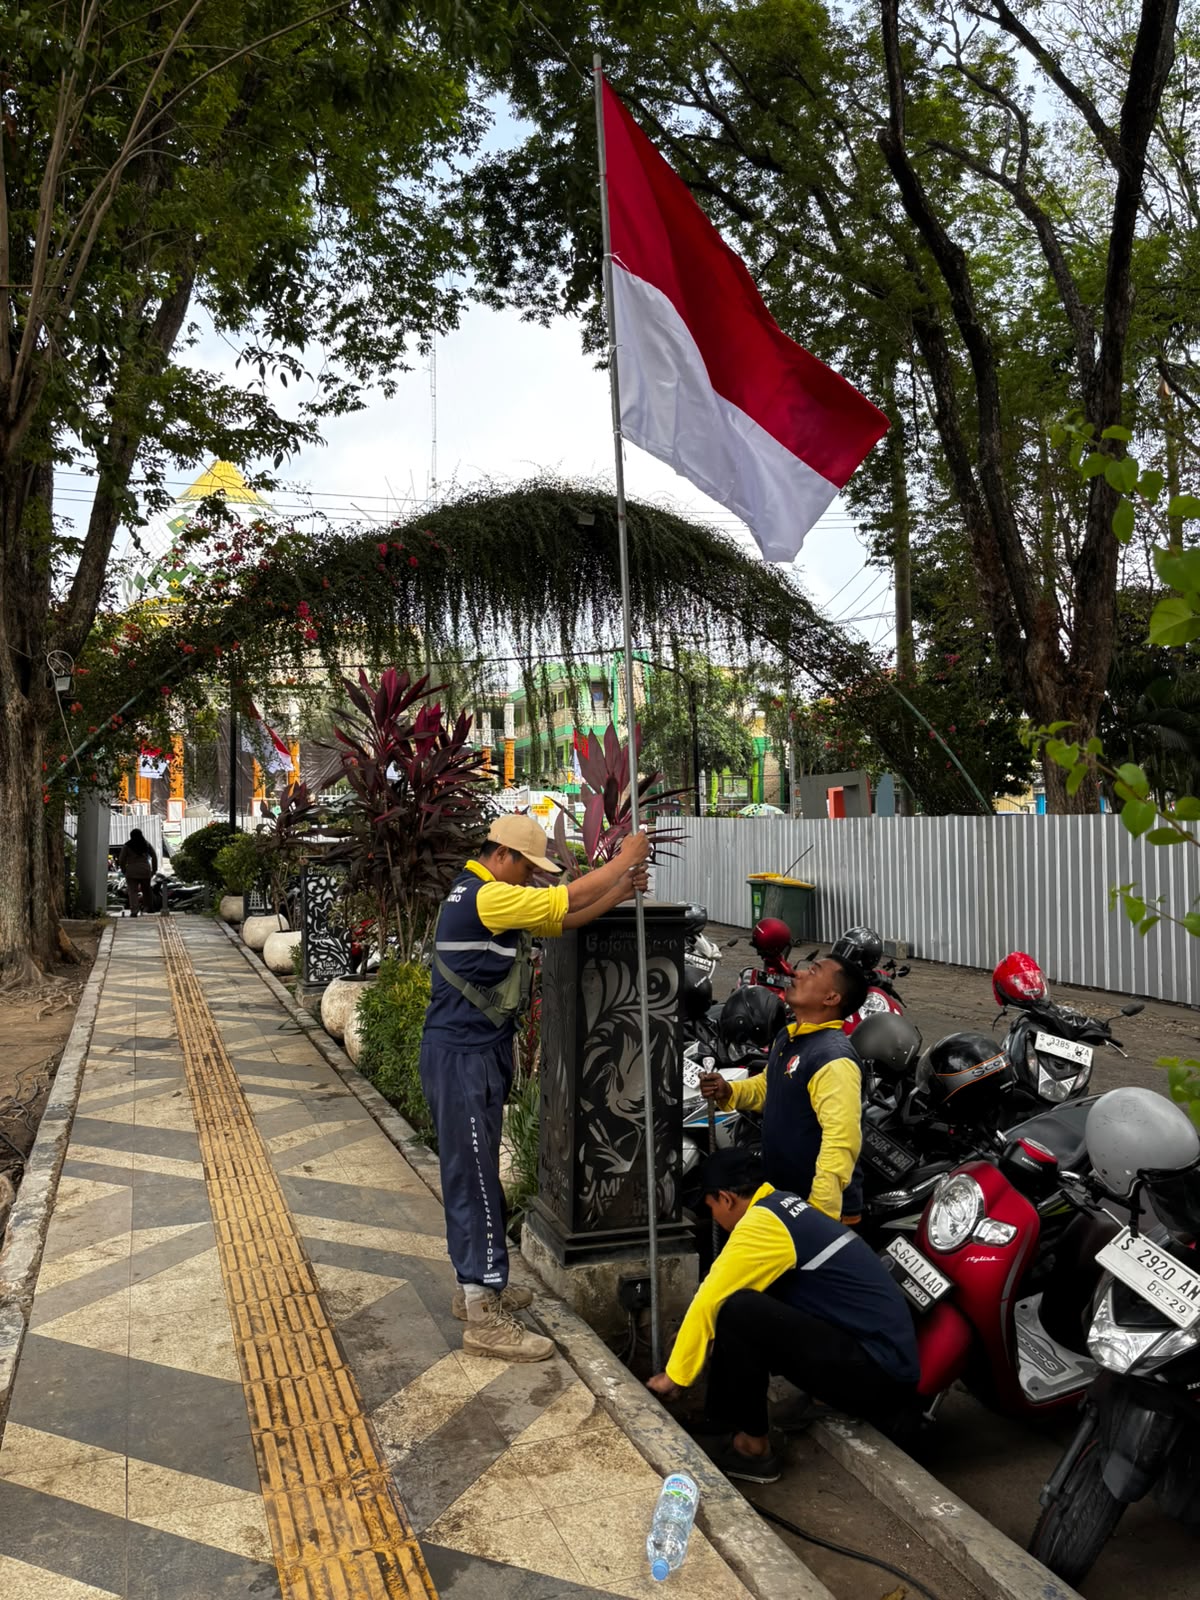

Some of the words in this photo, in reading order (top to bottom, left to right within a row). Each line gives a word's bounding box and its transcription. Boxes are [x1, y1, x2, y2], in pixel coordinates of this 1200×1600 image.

[891, 1241, 903, 1256] S
[898, 1248, 925, 1275] 6411
[1121, 1237, 1135, 1251] S
[1137, 1249, 1176, 1281] 2920
[1177, 1279, 1200, 1301] AN
